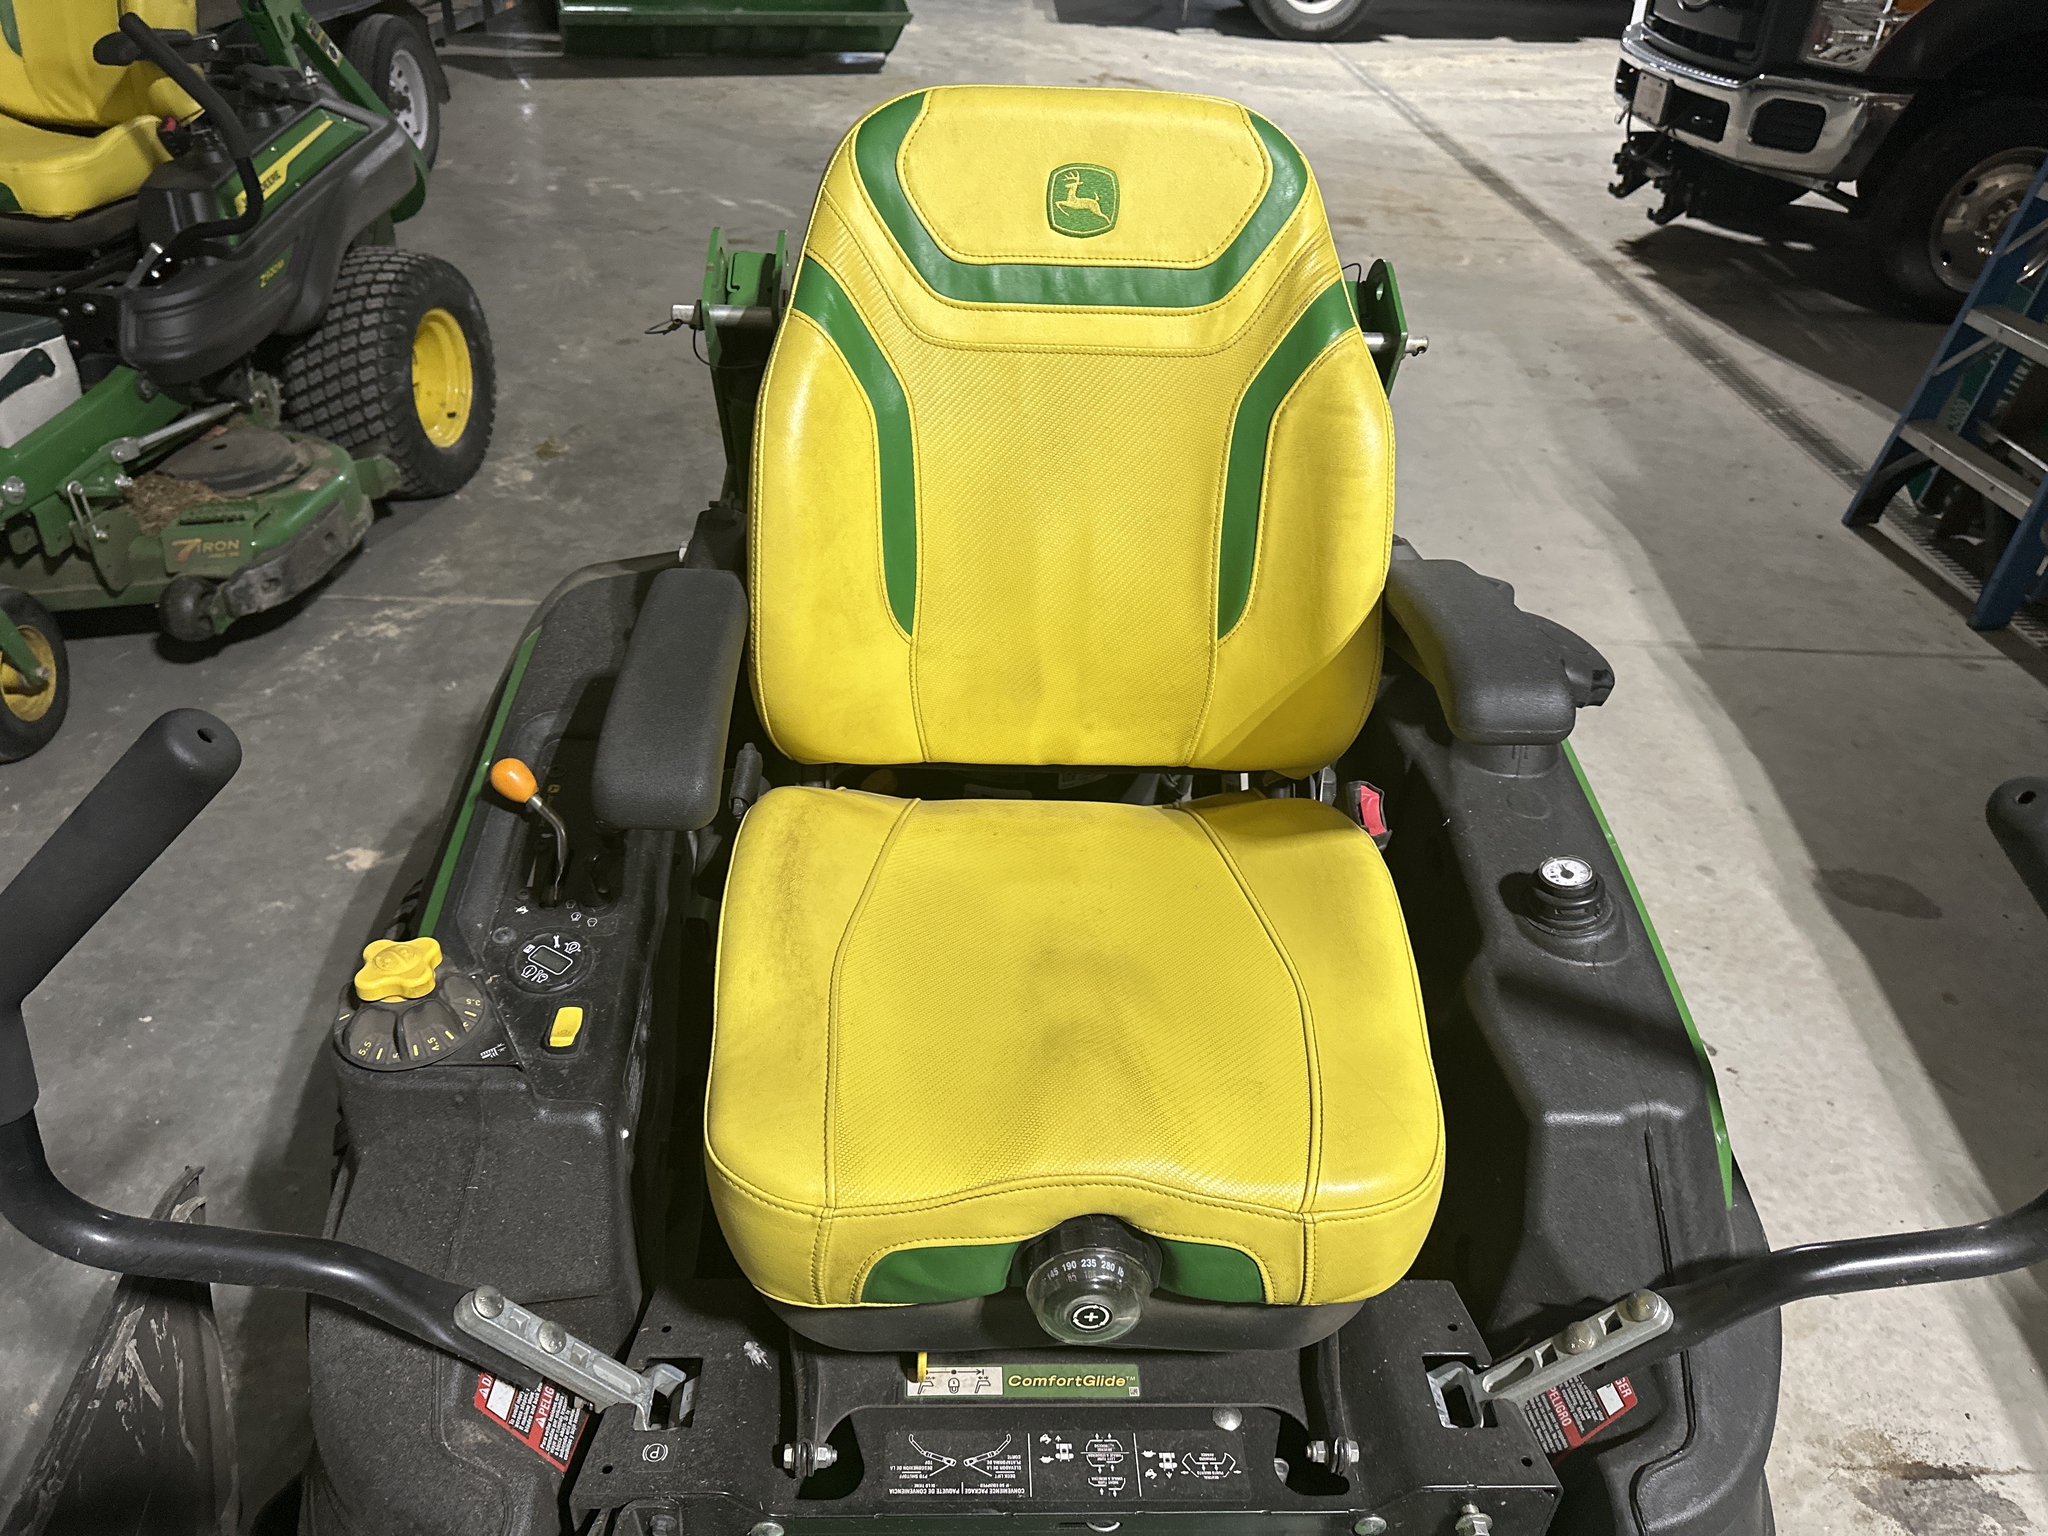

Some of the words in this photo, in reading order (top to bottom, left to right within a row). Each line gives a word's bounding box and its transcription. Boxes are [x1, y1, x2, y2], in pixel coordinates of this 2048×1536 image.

[466, 998, 481, 1006] 3.5
[358, 1041, 372, 1056] 5.5
[1047, 1267, 1059, 1280] 145
[1062, 1260, 1077, 1271] 190
[1081, 1259, 1097, 1268] 235
[1101, 1260, 1115, 1272] 280
[1118, 1266, 1124, 1278] lb
[1615, 1377, 1632, 1397] GER
[538, 1386, 554, 1417] PELIG
[515, 1411, 523, 1428] across
[521, 1405, 530, 1426] machine
[524, 1415, 533, 1433] blades
